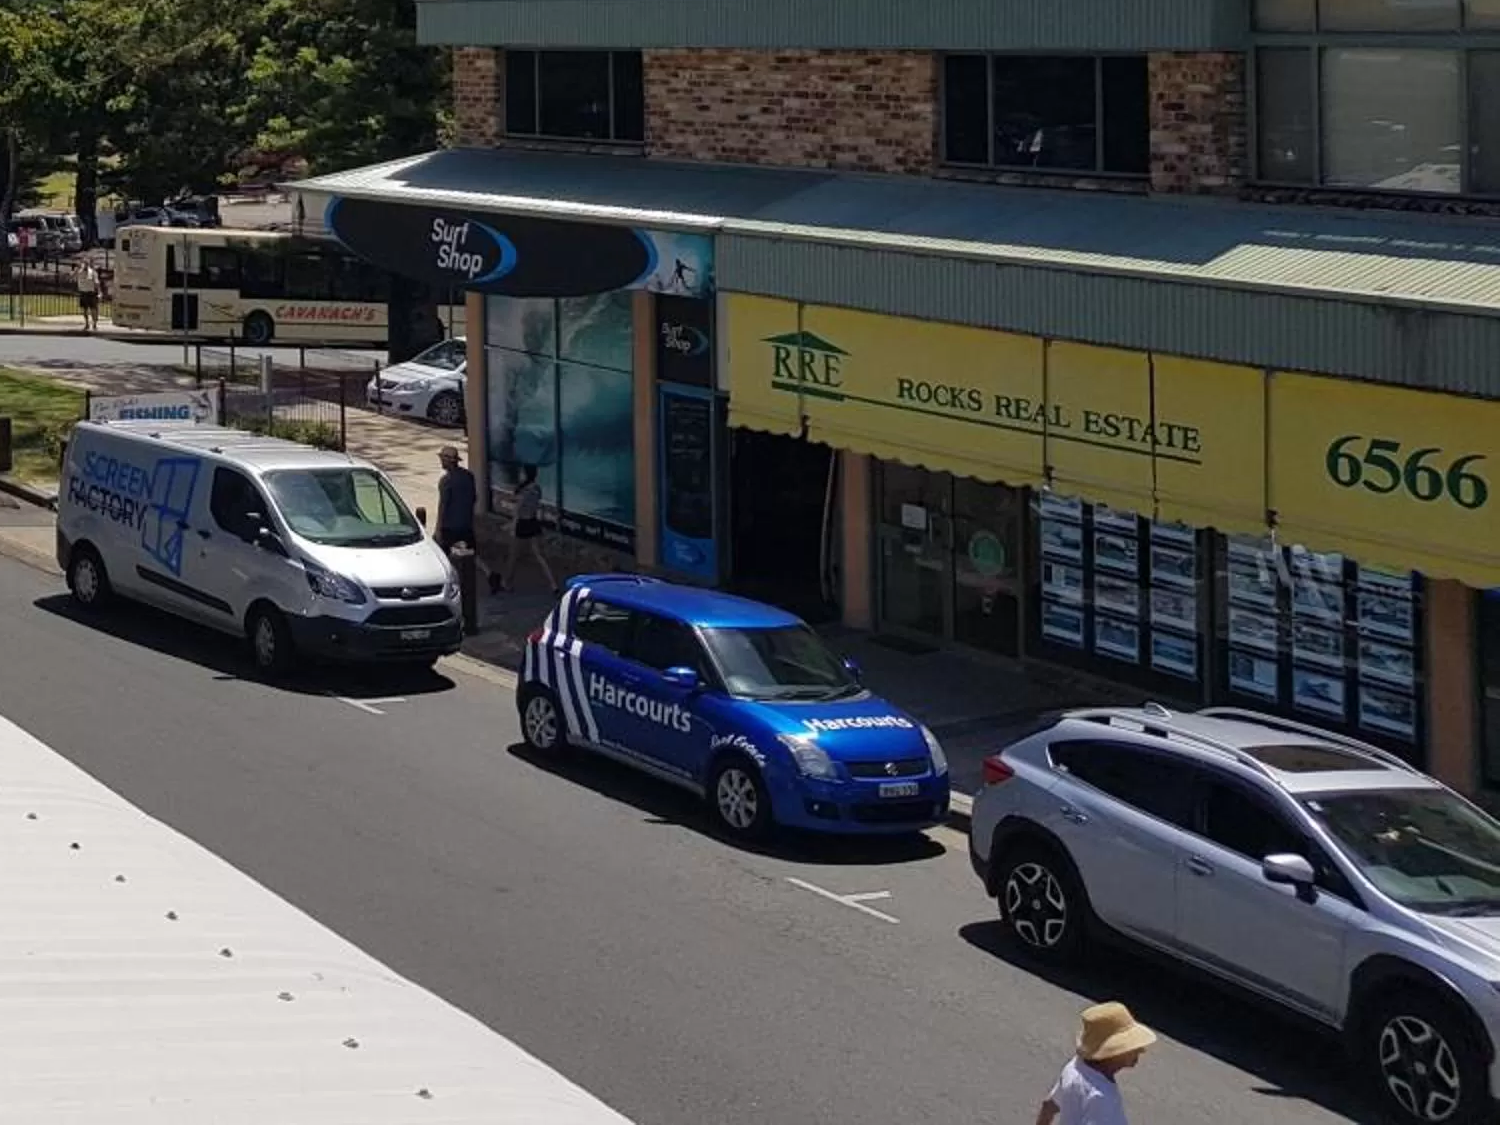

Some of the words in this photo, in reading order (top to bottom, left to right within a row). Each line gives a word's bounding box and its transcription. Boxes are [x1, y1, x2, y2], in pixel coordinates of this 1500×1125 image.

[432, 218, 469, 251] Surf
[437, 244, 483, 279] Shop
[772, 345, 844, 388] RRE
[897, 377, 983, 412] ROCKS
[994, 394, 1071, 428] REAL
[1083, 410, 1202, 453] ESTATE
[83, 450, 156, 499] SCREEN
[1326, 435, 1488, 510] 6566
[67, 475, 148, 531] FACTORY
[590, 672, 691, 732] Harcourts
[802, 715, 913, 733] Harcourts
